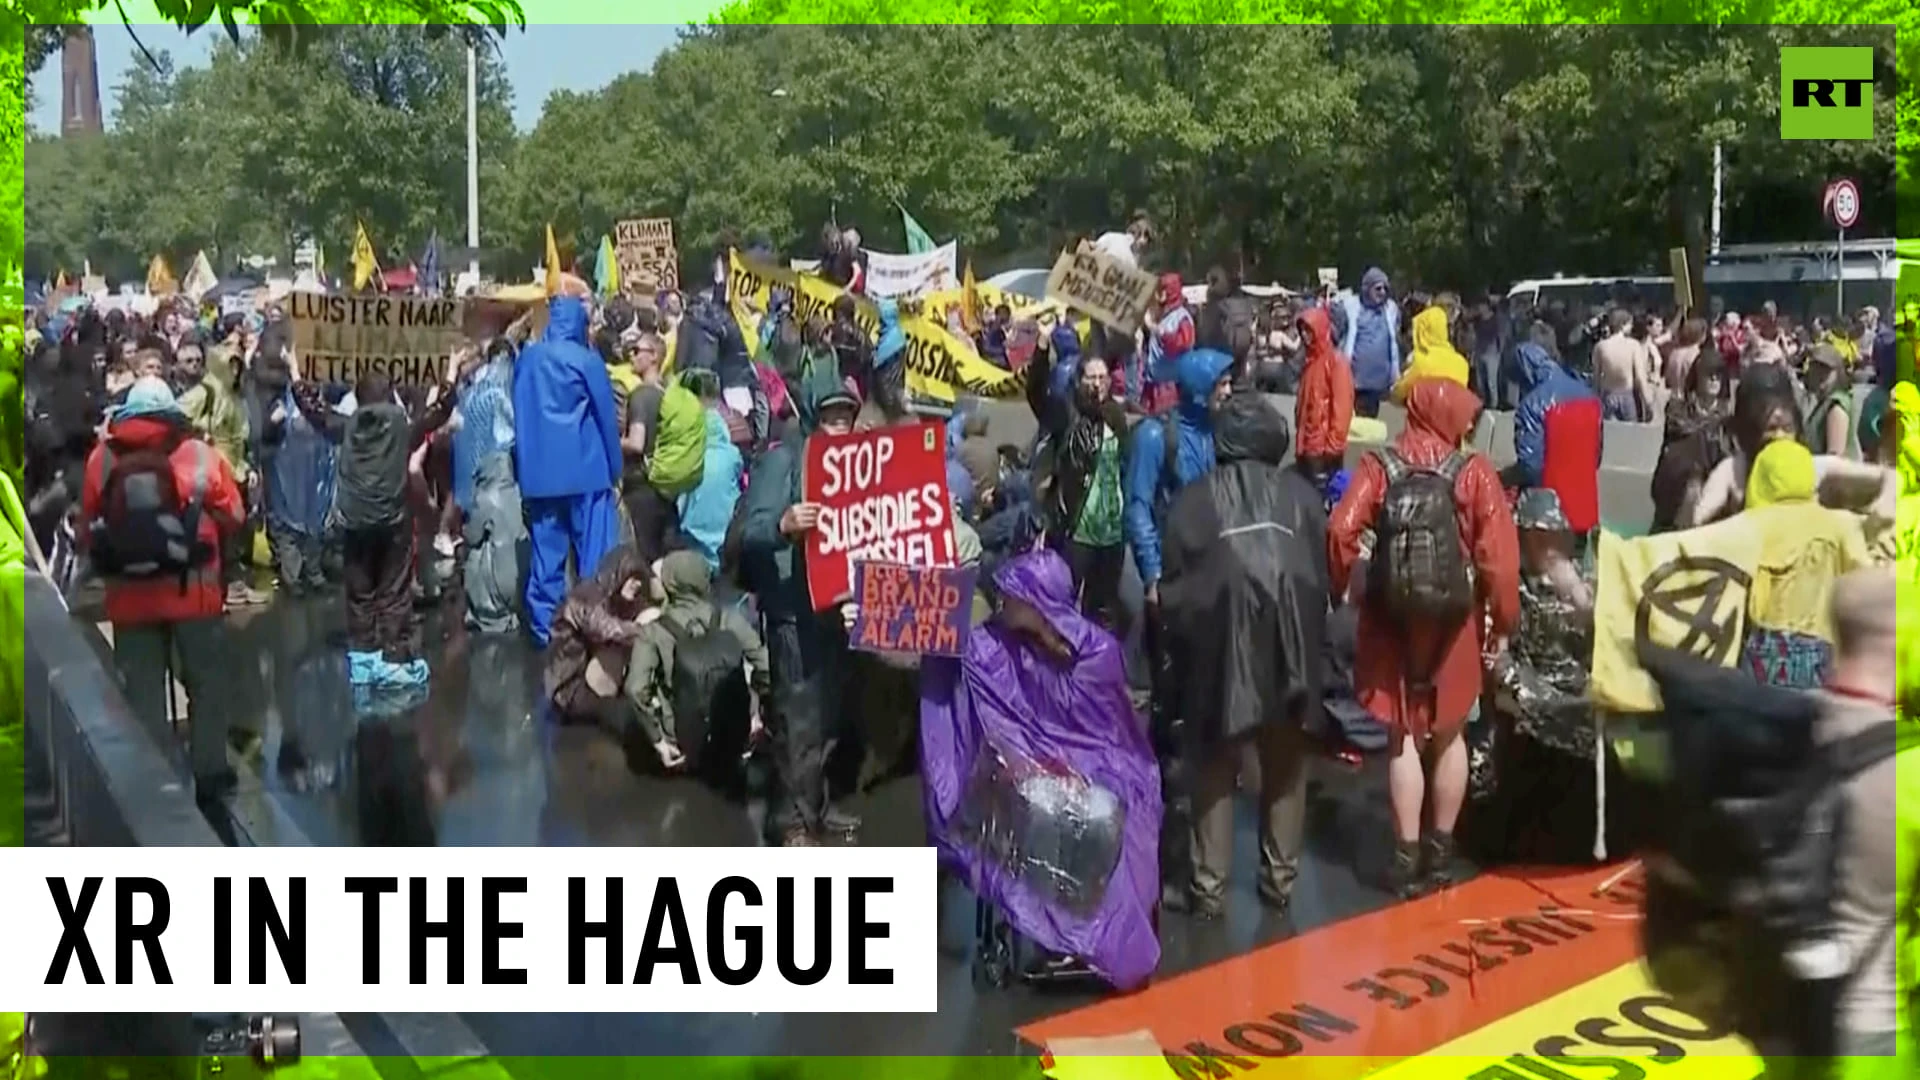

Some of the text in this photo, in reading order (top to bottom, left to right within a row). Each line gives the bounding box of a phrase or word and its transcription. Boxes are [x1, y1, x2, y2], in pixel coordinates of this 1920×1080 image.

[1839, 194, 1853, 212] 50
[291, 293, 391, 326] LUISTER
[400, 302, 455, 327] NAAR
[821, 435, 894, 498] STOP
[816, 482, 945, 556] SUBSIDIES
[863, 576, 960, 610] BRAND
[860, 619, 958, 655] ALARM
[1163, 905, 1596, 1080] JUSTICE NOW
